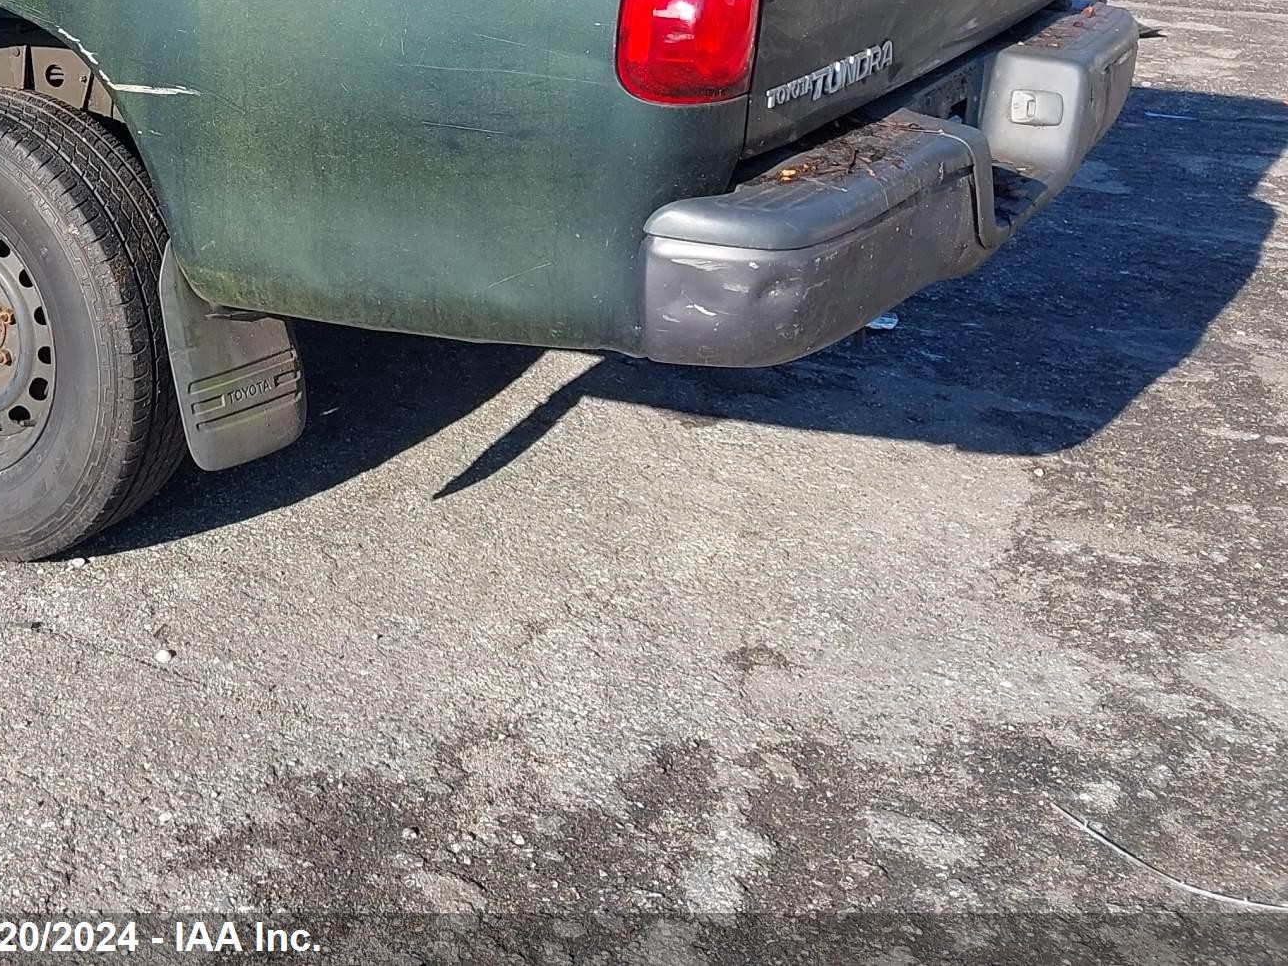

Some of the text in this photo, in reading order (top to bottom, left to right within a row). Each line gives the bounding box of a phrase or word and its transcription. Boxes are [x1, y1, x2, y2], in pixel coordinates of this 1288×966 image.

[766, 40, 893, 109] TOYOTA TUNDRA
[227, 379, 272, 404] TOYOTA
